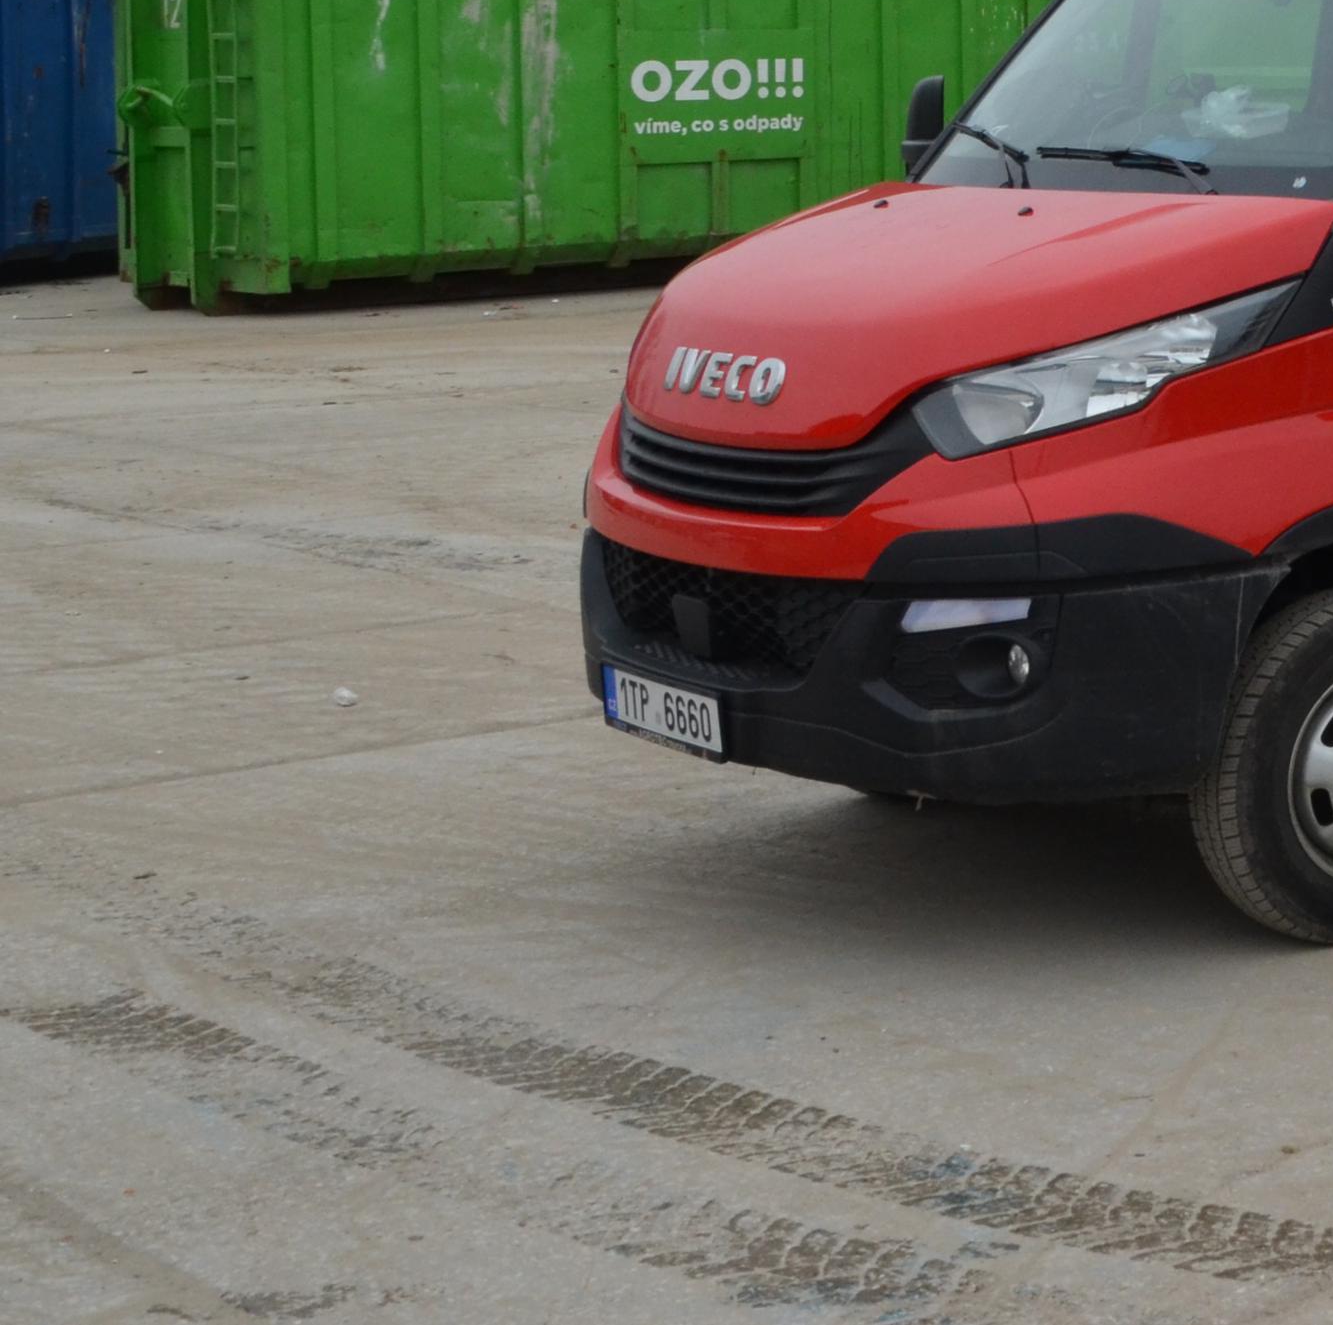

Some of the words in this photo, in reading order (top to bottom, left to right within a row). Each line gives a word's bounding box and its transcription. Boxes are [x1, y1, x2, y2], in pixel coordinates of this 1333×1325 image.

[630, 58, 805, 103] OZO!!!
[634, 118, 688, 136] víme,
[691, 119, 715, 133] co
[718, 119, 730, 132] s
[733, 113, 804, 133] odpady
[663, 346, 786, 406] IVECO
[620, 677, 649, 722] 1TP
[663, 691, 712, 743] 6660
